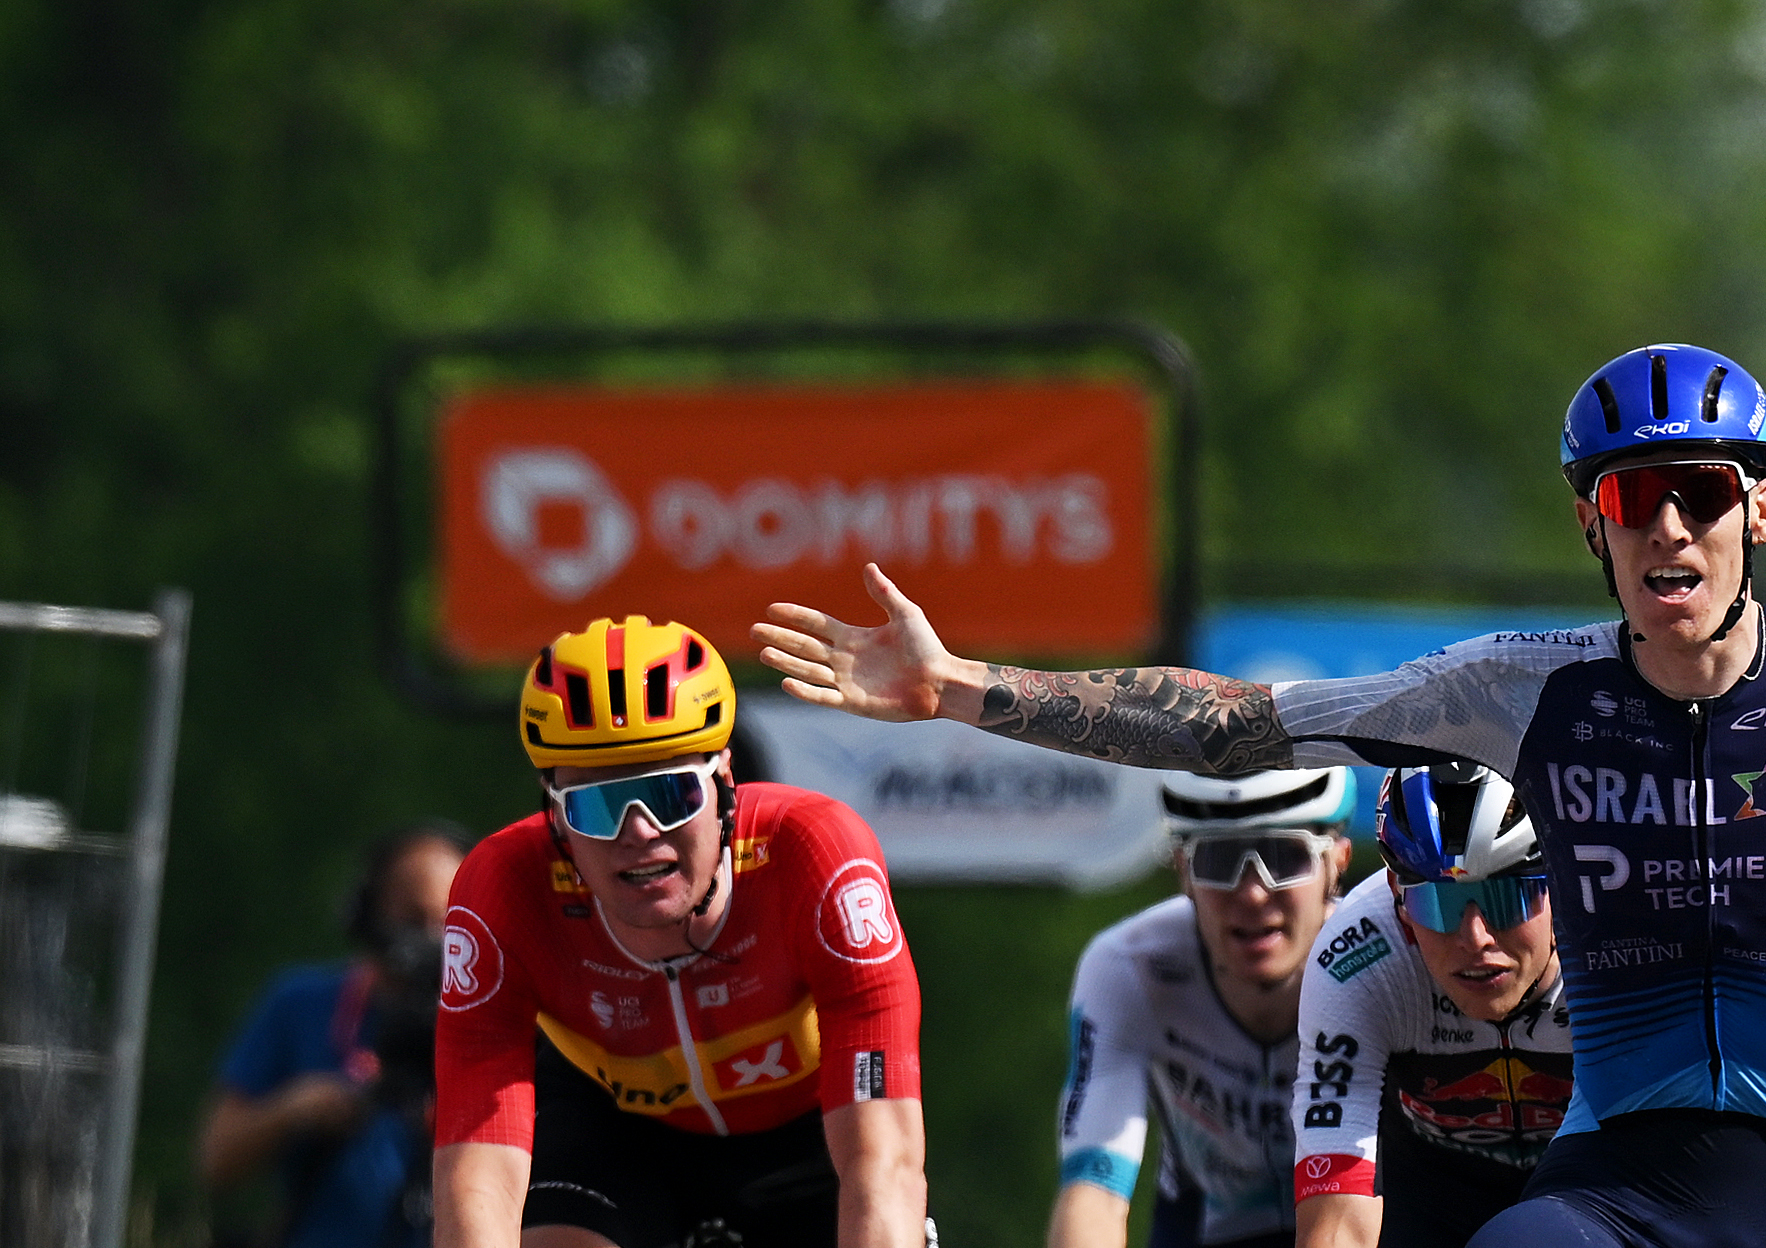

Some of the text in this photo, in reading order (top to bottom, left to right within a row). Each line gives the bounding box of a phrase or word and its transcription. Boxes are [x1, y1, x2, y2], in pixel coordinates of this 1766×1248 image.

[650, 475, 1114, 569] DOMITYS
[1624, 696, 1646, 709] UCI
[1624, 706, 1647, 718] PRO
[1625, 715, 1656, 728] TEAM
[1600, 729, 1674, 751] BLACK INC
[1547, 762, 1727, 827] ISRAEL
[1645, 884, 1731, 910] TECH
[1317, 916, 1381, 970] BORA
[1601, 937, 1658, 950] CANTINA
[1723, 947, 1766, 961] PEACE
[1586, 942, 1684, 972] FANTINI
